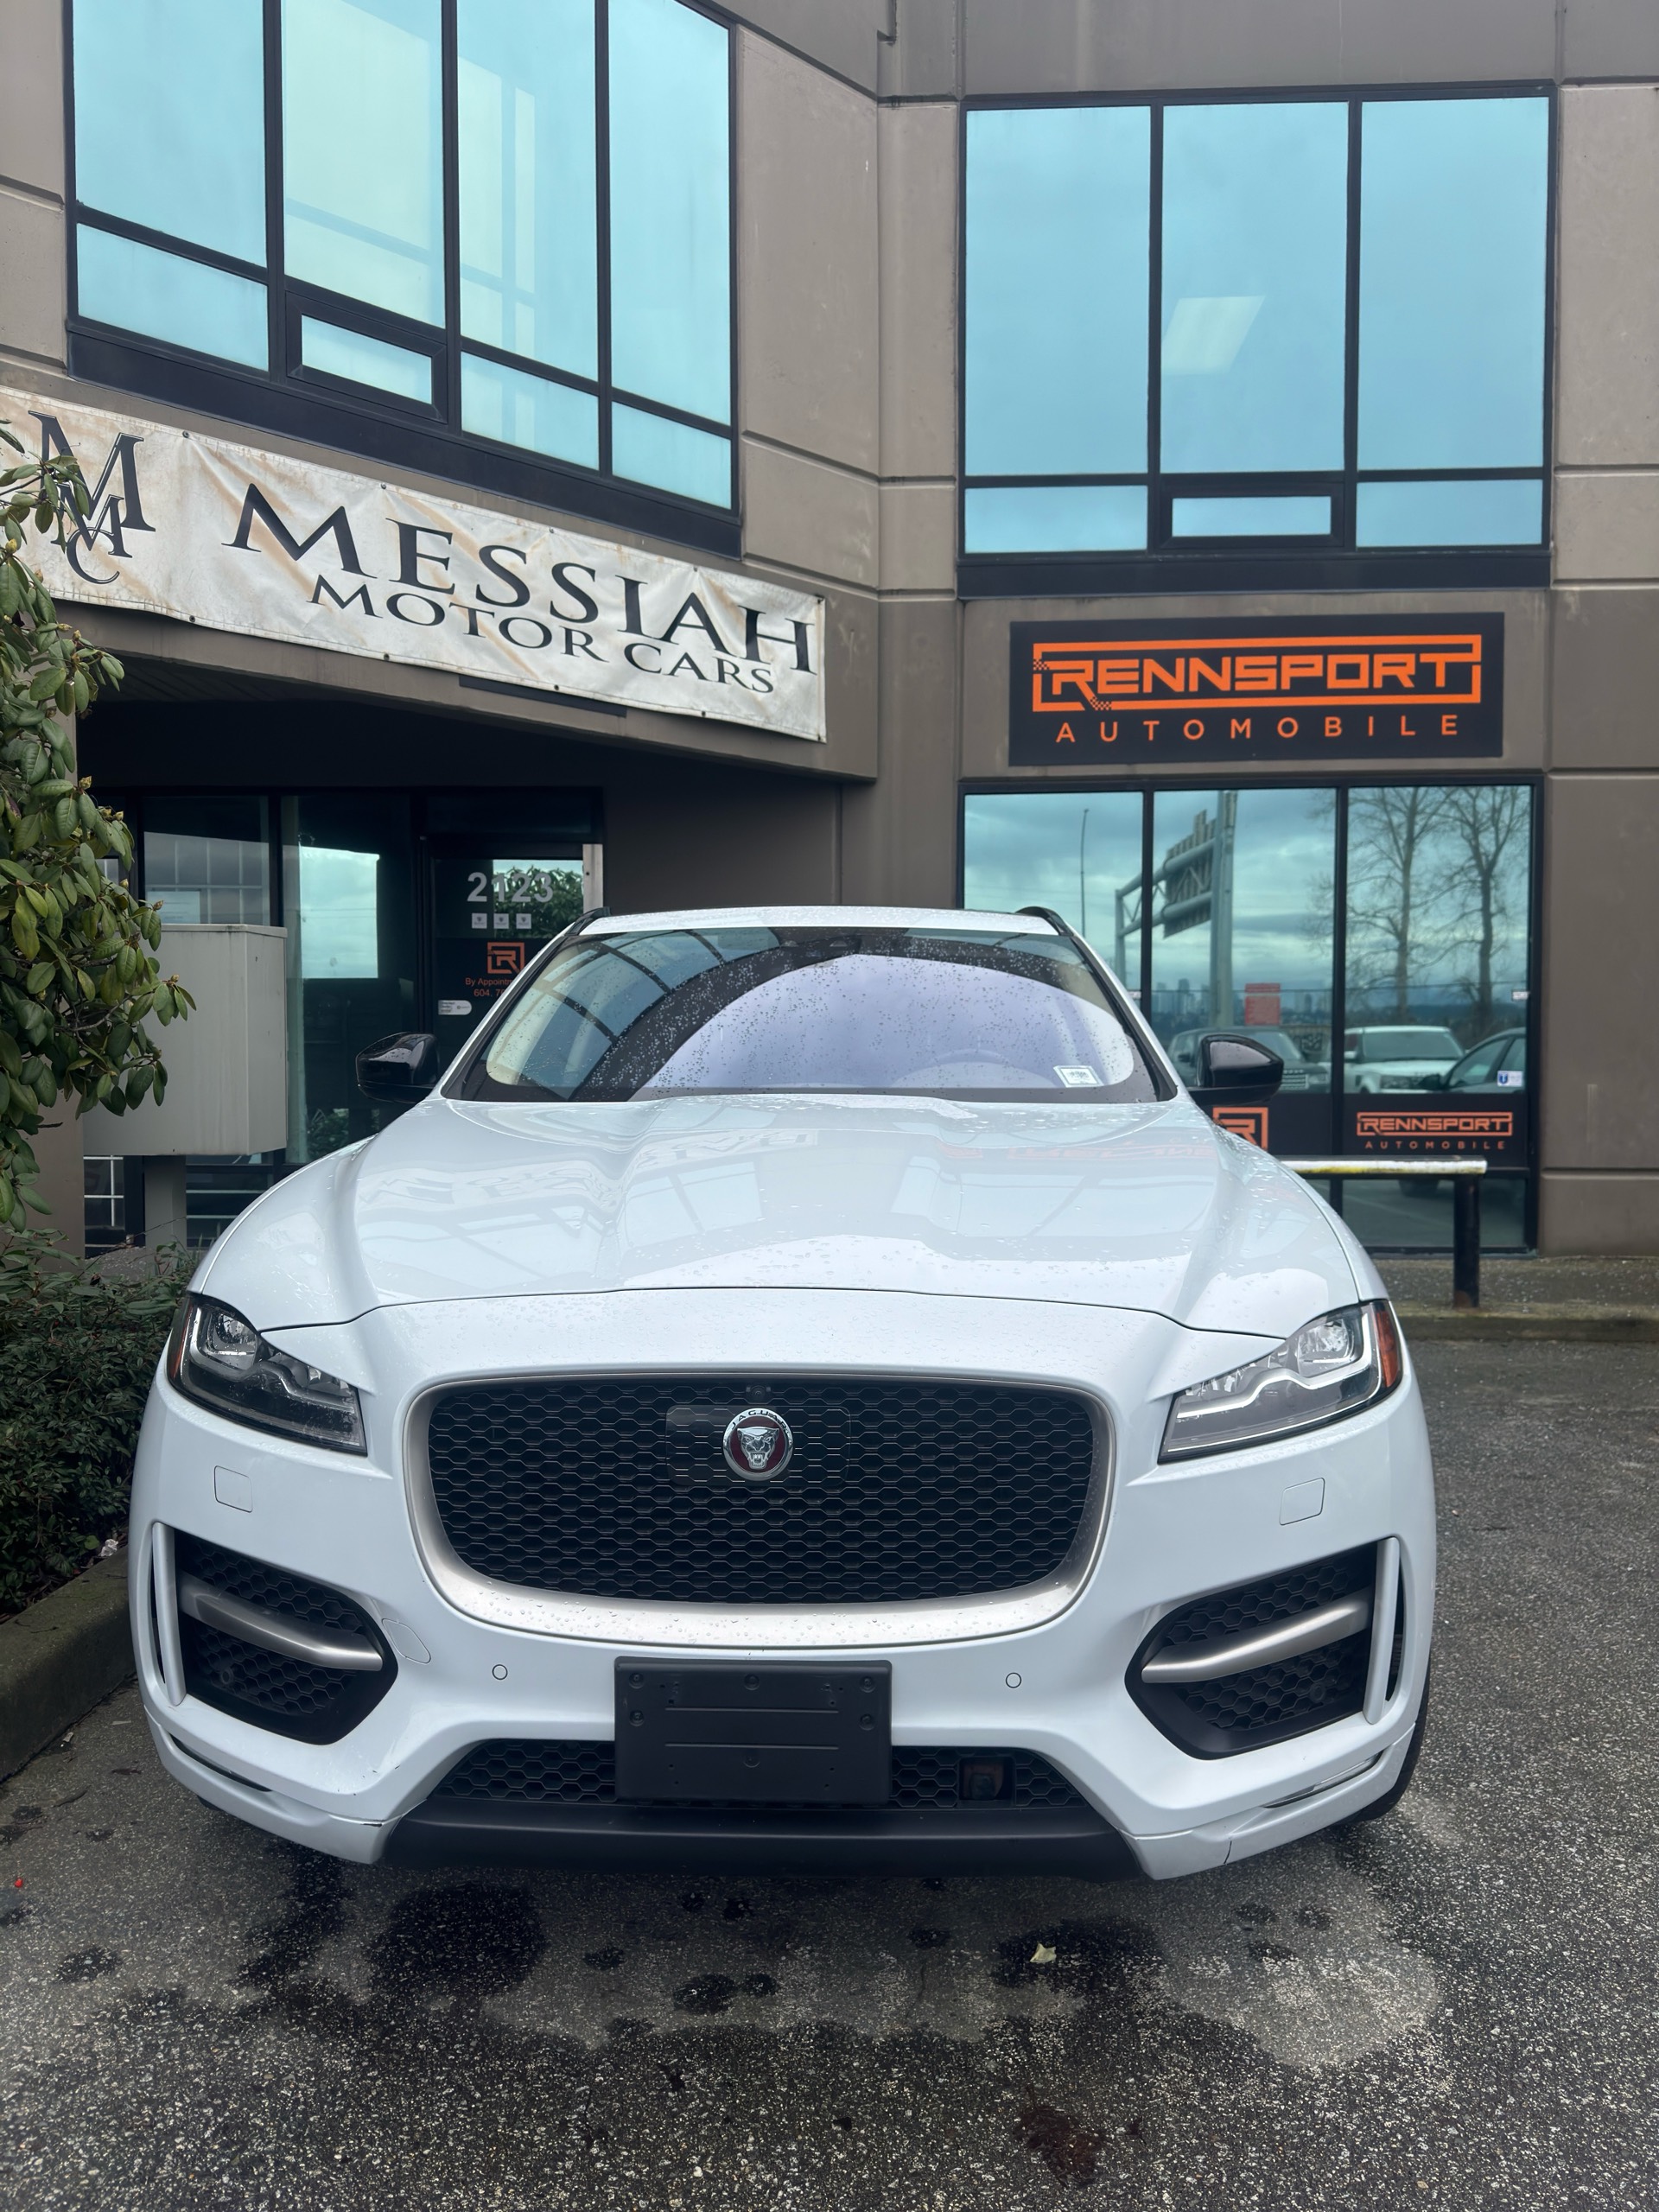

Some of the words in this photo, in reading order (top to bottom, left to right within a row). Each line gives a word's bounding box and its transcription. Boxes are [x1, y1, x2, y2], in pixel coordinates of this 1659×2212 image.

[222, 483, 817, 676] MESSIAH
[306, 574, 609, 663] MOTOR
[623, 641, 775, 694] CARS
[1035, 651, 1481, 710] RENNSPORT
[1055, 714, 1458, 743] AUTOMOBILE
[467, 871, 554, 903] 2123
[465, 977, 475, 986] By
[1359, 1116, 1512, 1134] RENNSPORT
[1364, 1141, 1506, 1150] AUTOMOBILE
[731, 1409, 787, 1431] JAGUAR
